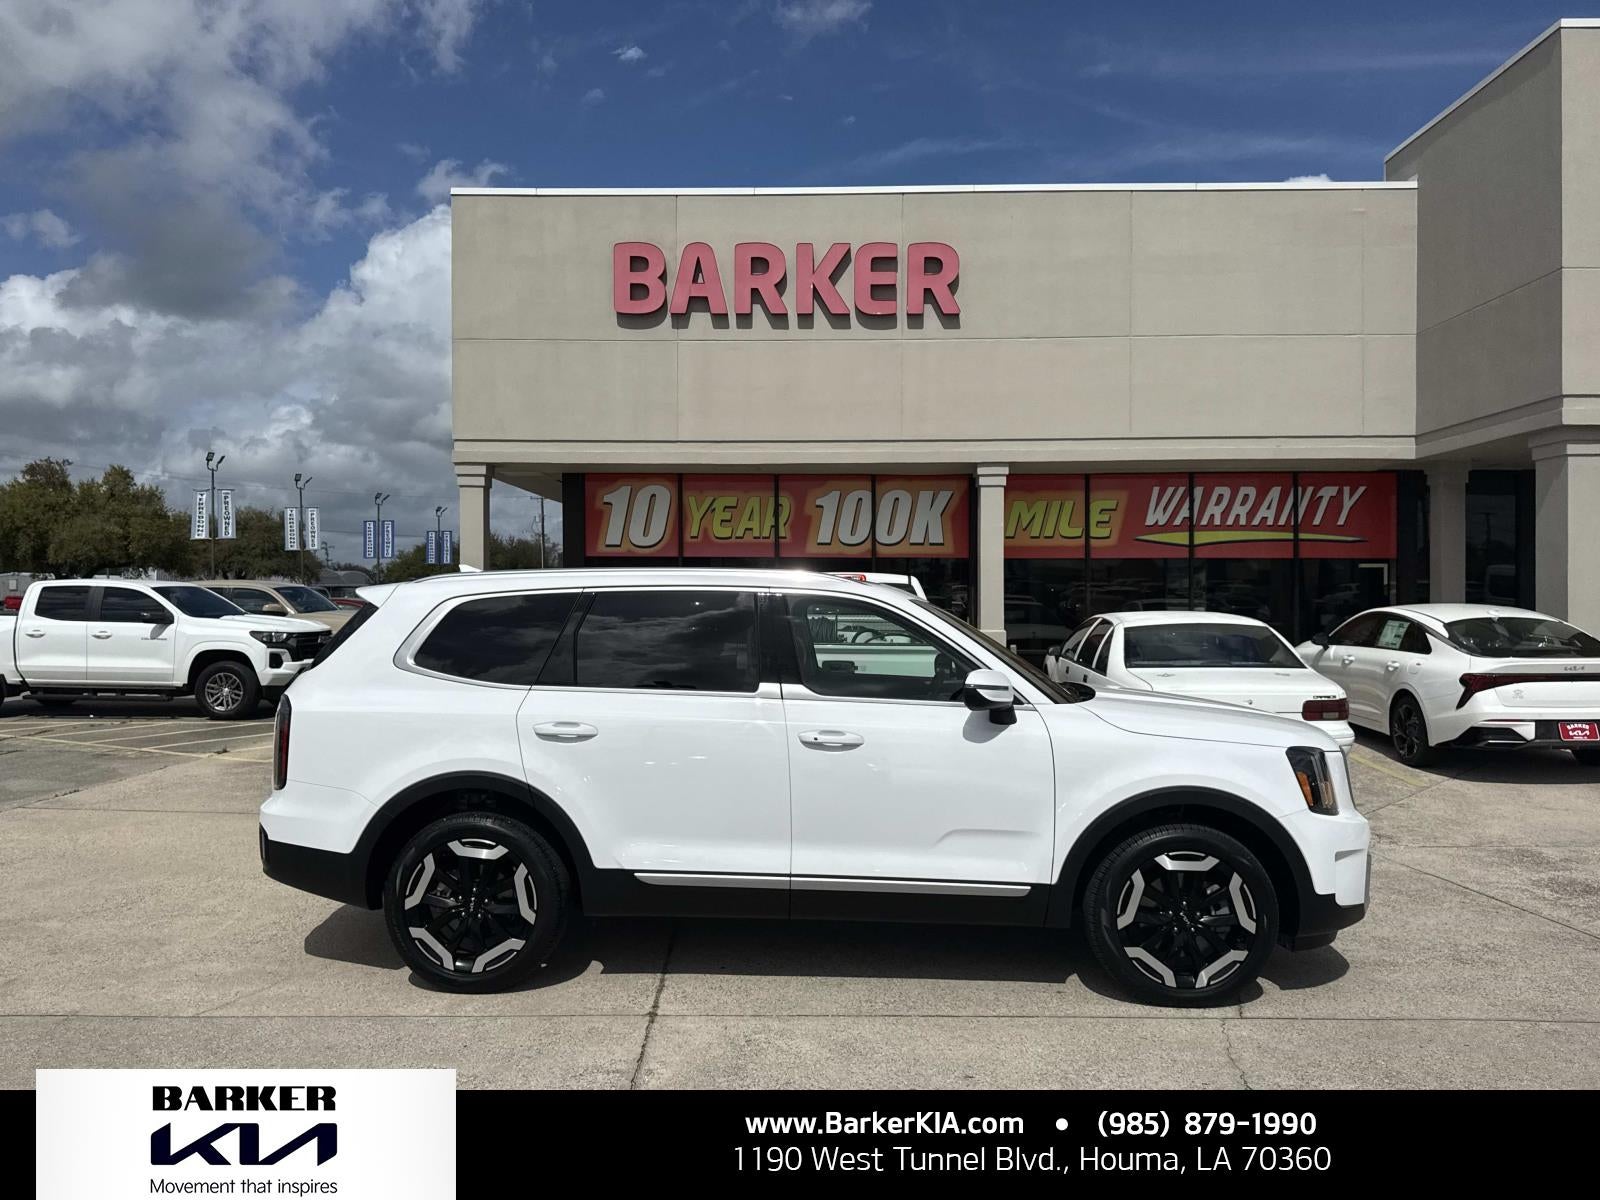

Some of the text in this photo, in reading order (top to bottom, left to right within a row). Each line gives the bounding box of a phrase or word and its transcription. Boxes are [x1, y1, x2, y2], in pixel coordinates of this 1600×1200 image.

[613, 241, 961, 316] BARKER
[223, 495, 232, 537] PREOWNED
[602, 484, 1367, 548] 10 YEAR 100K MILE WARRANTY
